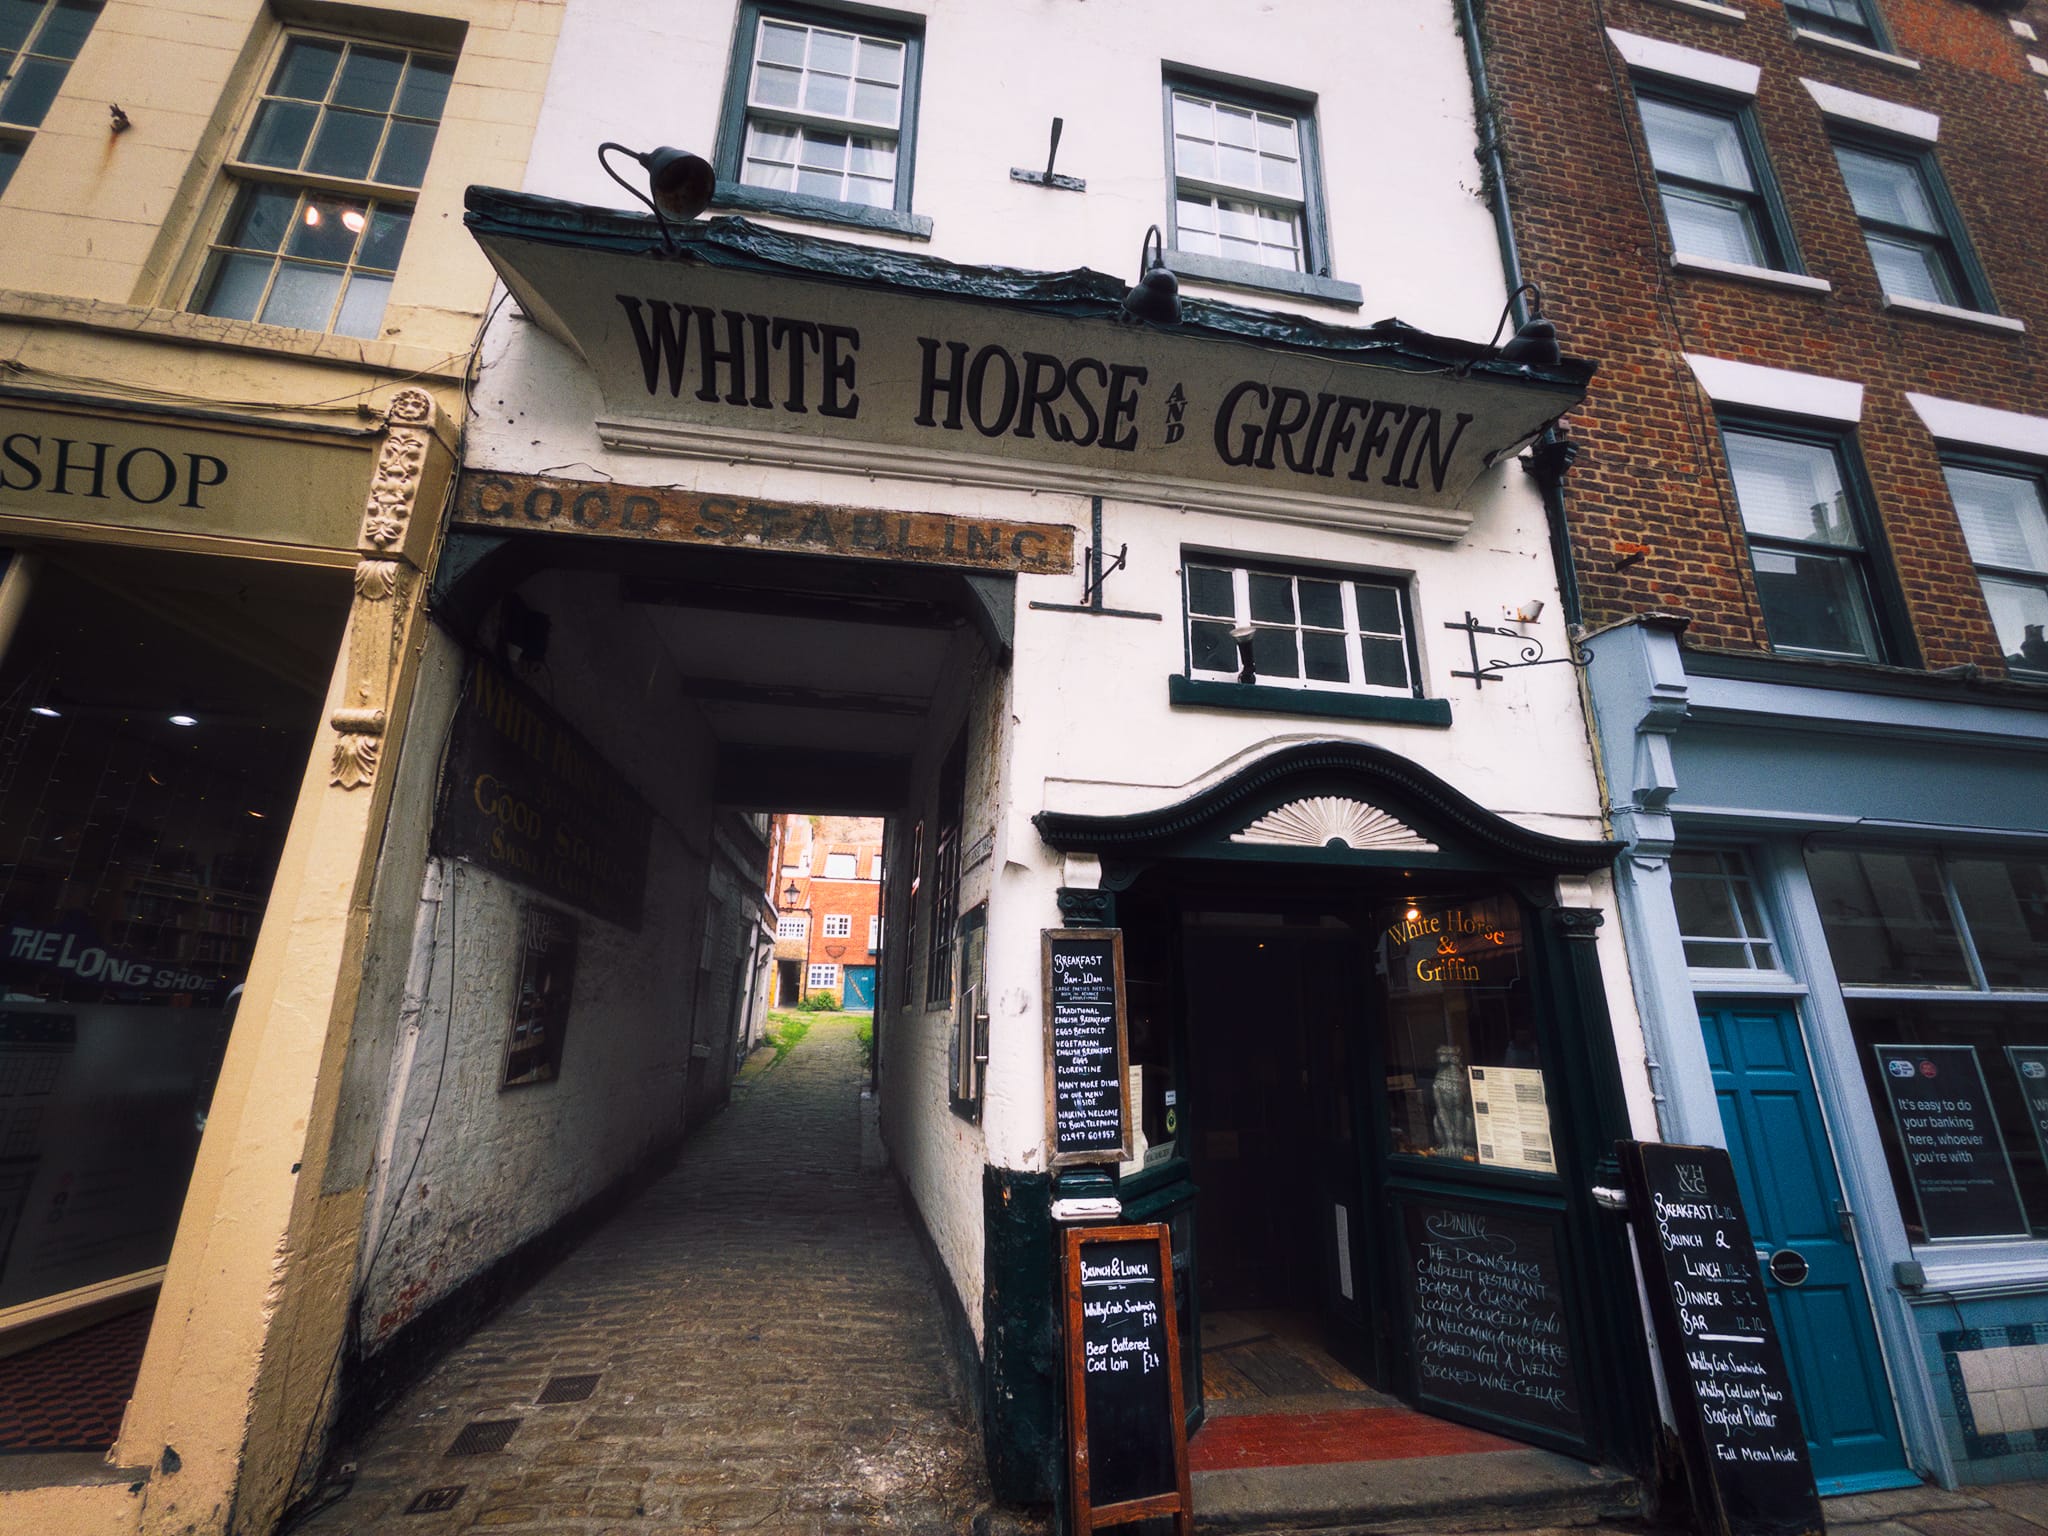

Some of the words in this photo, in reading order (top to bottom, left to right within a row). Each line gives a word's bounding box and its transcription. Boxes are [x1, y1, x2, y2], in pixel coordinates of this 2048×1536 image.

[616, 294, 860, 420] WHITE
[913, 336, 1149, 452] HORSE
[1163, 382, 1189, 446] AND
[1214, 380, 1474, 493] GRIFFIN
[0, 432, 229, 509] SHOP
[473, 475, 662, 534] GOOD
[692, 498, 1049, 564] STABLING
[1388, 914, 1441, 946] White
[1448, 910, 1504, 945] Horse
[1436, 935, 1457, 955] &
[9, 927, 62, 961] THE
[58, 934, 153, 986] LONG
[1054, 954, 1103, 973] BREAKFAST
[1416, 957, 1480, 982] Griffin
[1054, 1016, 1078, 1024] ENGLISH
[1055, 1005, 1100, 1015] TRADITIONAL
[1055, 1027, 1073, 1036] EGGS
[1073, 1026, 1106, 1037] BENEDICT
[1055, 1039, 1099, 1048] VEGETARIAN
[1057, 1065, 1102, 1075] FLORENTINE
[1057, 1080, 1079, 1090] MANY
[1080, 1080, 1099, 1089] MORE
[1070, 1091, 1083, 1099] OUR
[1087, 1108, 1119, 1118] WELCOME
[1898, 1098, 1916, 1112] It's
[1917, 1100, 1942, 1114] easy
[1942, 1099, 1956, 1112] to
[1957, 1099, 1972, 1112] do
[1057, 1121, 1067, 1129] TO
[1068, 1119, 1087, 1131] BOOK
[1903, 1118, 1928, 1131] your
[1930, 1116, 1974, 1131] banking
[1907, 1133, 1937, 1147] here,
[1937, 1133, 1984, 1146] whoever
[1911, 1151, 1948, 1166] you're
[1948, 1151, 1974, 1164] with
[1654, 1192, 1714, 1223] BREAKFAST
[1660, 1222, 1703, 1252] BRUNCH
[1421, 1242, 1453, 1262] THE
[1120, 1260, 1149, 1276] LUNCH
[1682, 1253, 1722, 1279] LUNCH
[1478, 1271, 1549, 1301] RESTAURANT
[1673, 1280, 1723, 1307] DINNER
[1420, 1295, 1462, 1318] LOCALLY
[1680, 1308, 1709, 1336] BAR
[1086, 1341, 1108, 1357] Beer
[1111, 1336, 1151, 1354] Battered
[1087, 1358, 1107, 1373] Cod
[1686, 1351, 1714, 1377] Whitby
[1478, 1372, 1513, 1391] WINE
[1512, 1380, 1576, 1413] CELLAR
[1695, 1380, 1726, 1404] Whitby
[1703, 1403, 1743, 1437] Seafood
[1742, 1404, 1778, 1428] Platter
[1716, 1443, 1738, 1461] Full
[1740, 1447, 1771, 1461] Menu
[1769, 1445, 1800, 1462] Inside
